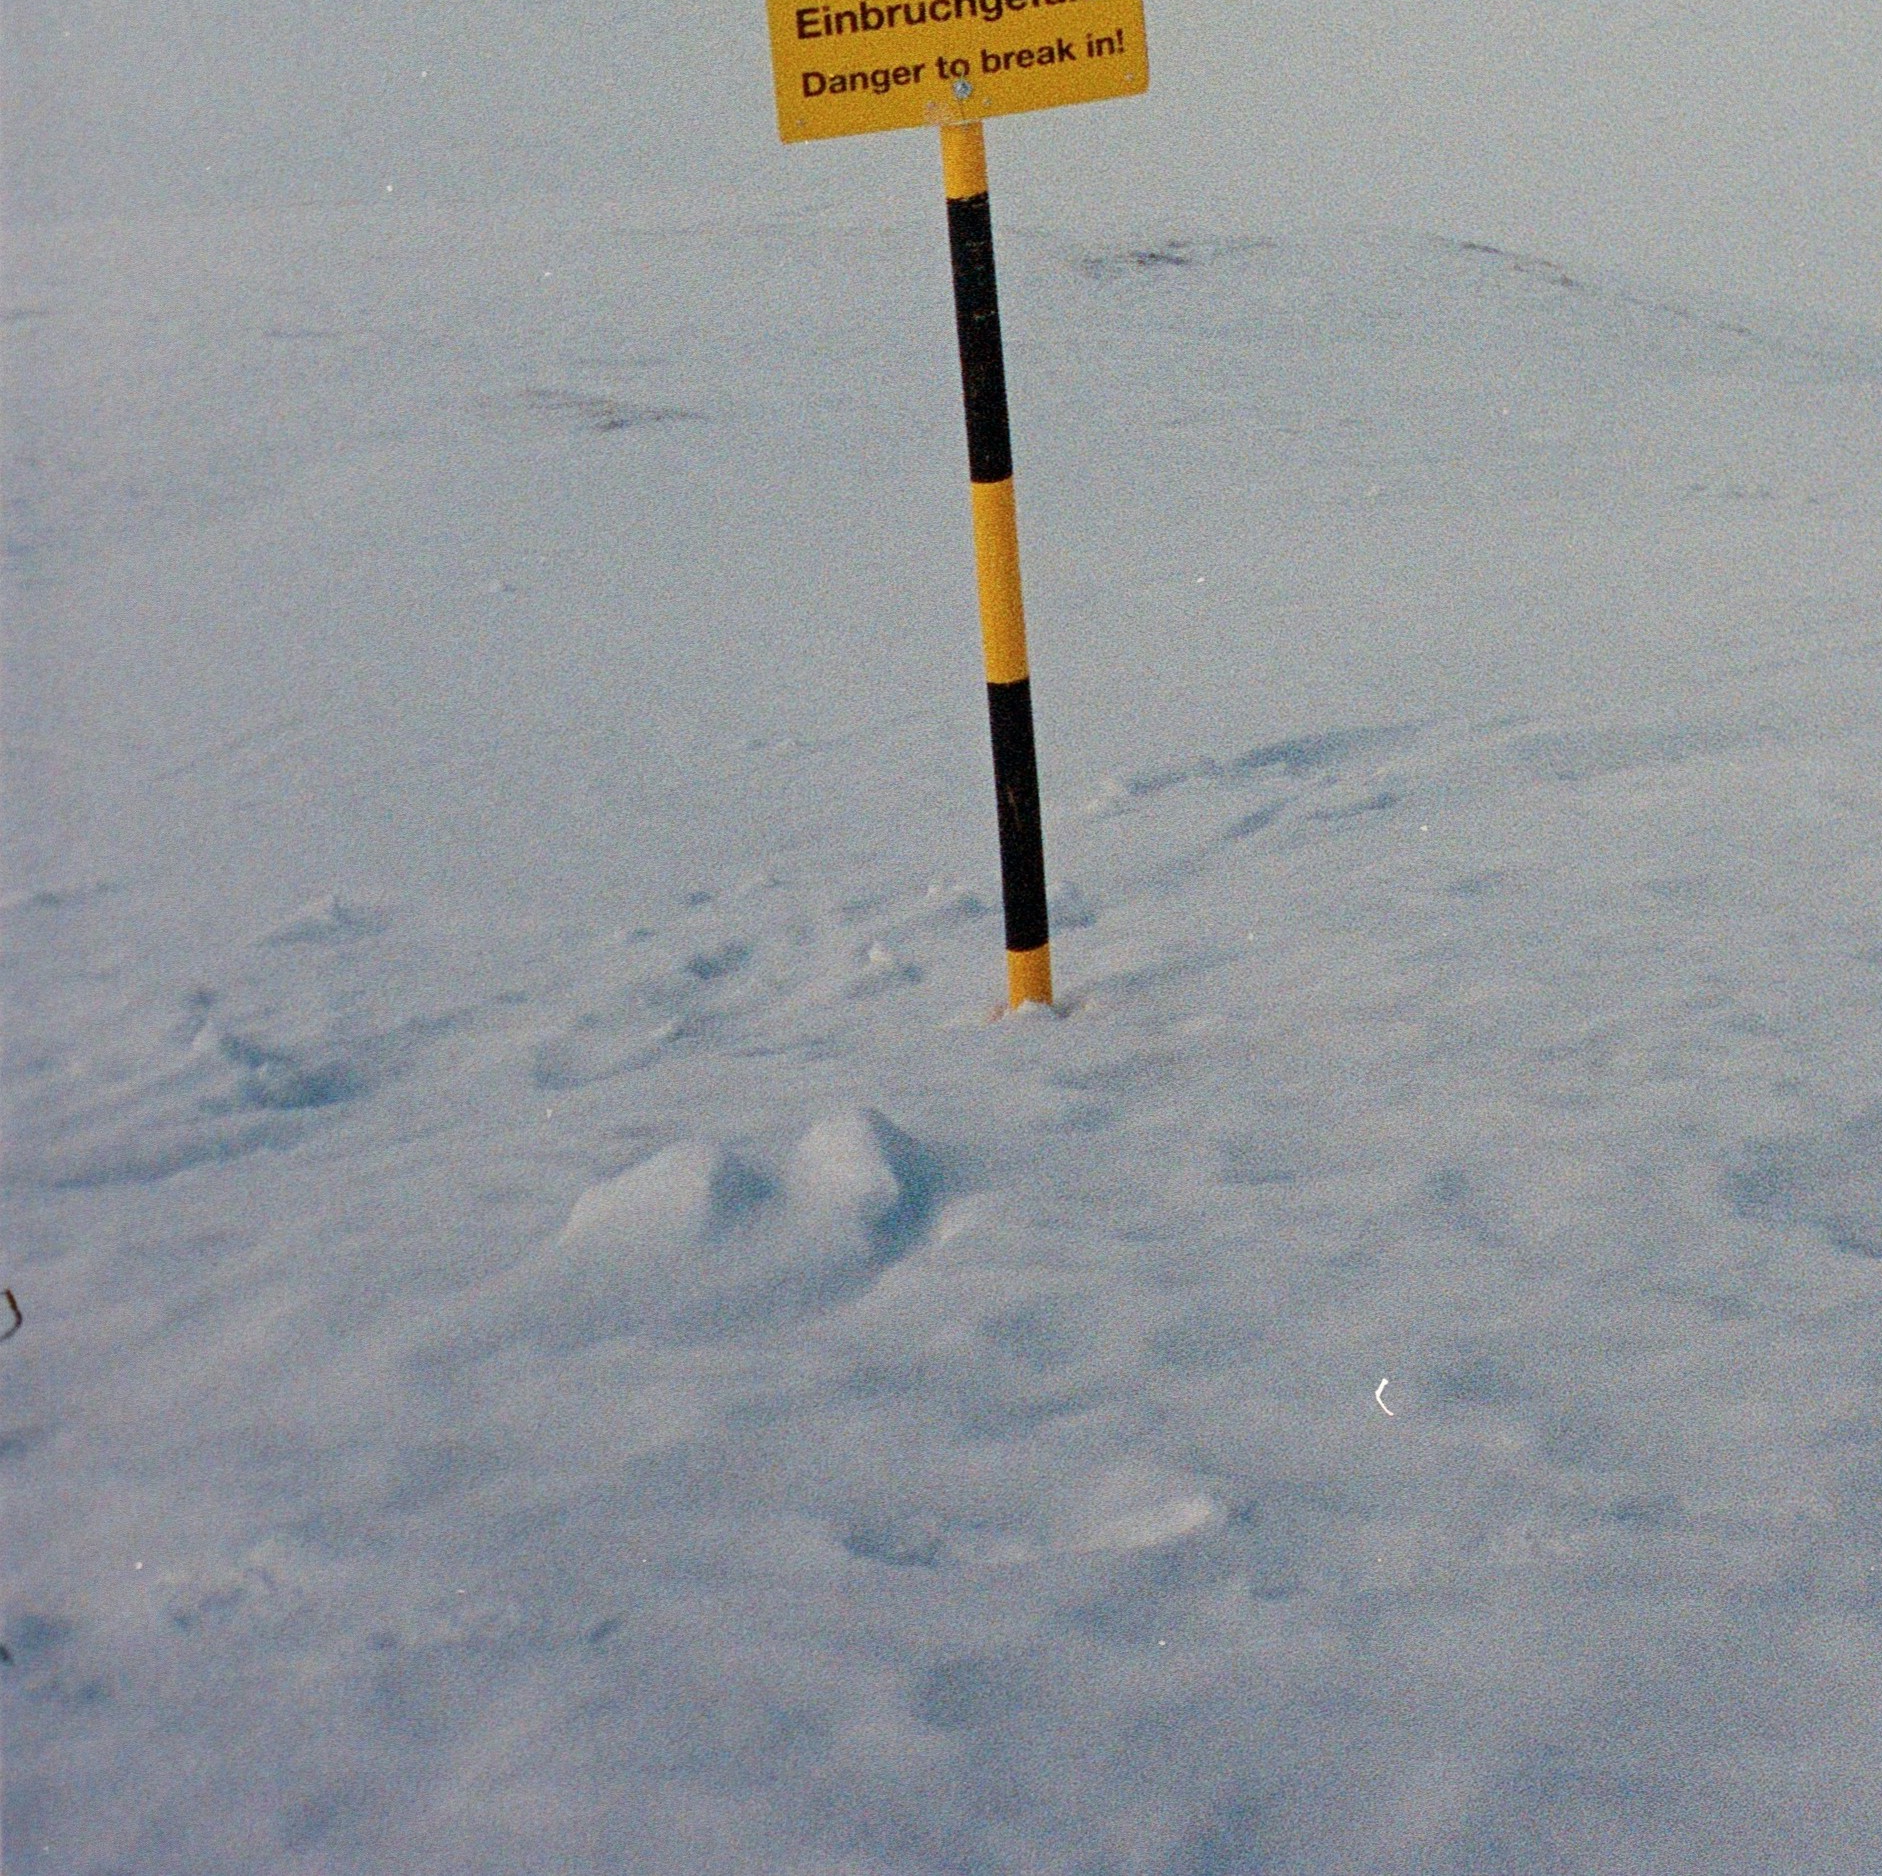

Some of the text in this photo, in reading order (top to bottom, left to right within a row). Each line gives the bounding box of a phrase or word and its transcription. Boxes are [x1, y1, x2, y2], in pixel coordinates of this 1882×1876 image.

[802, 28, 1125, 98] Danger to break in!
